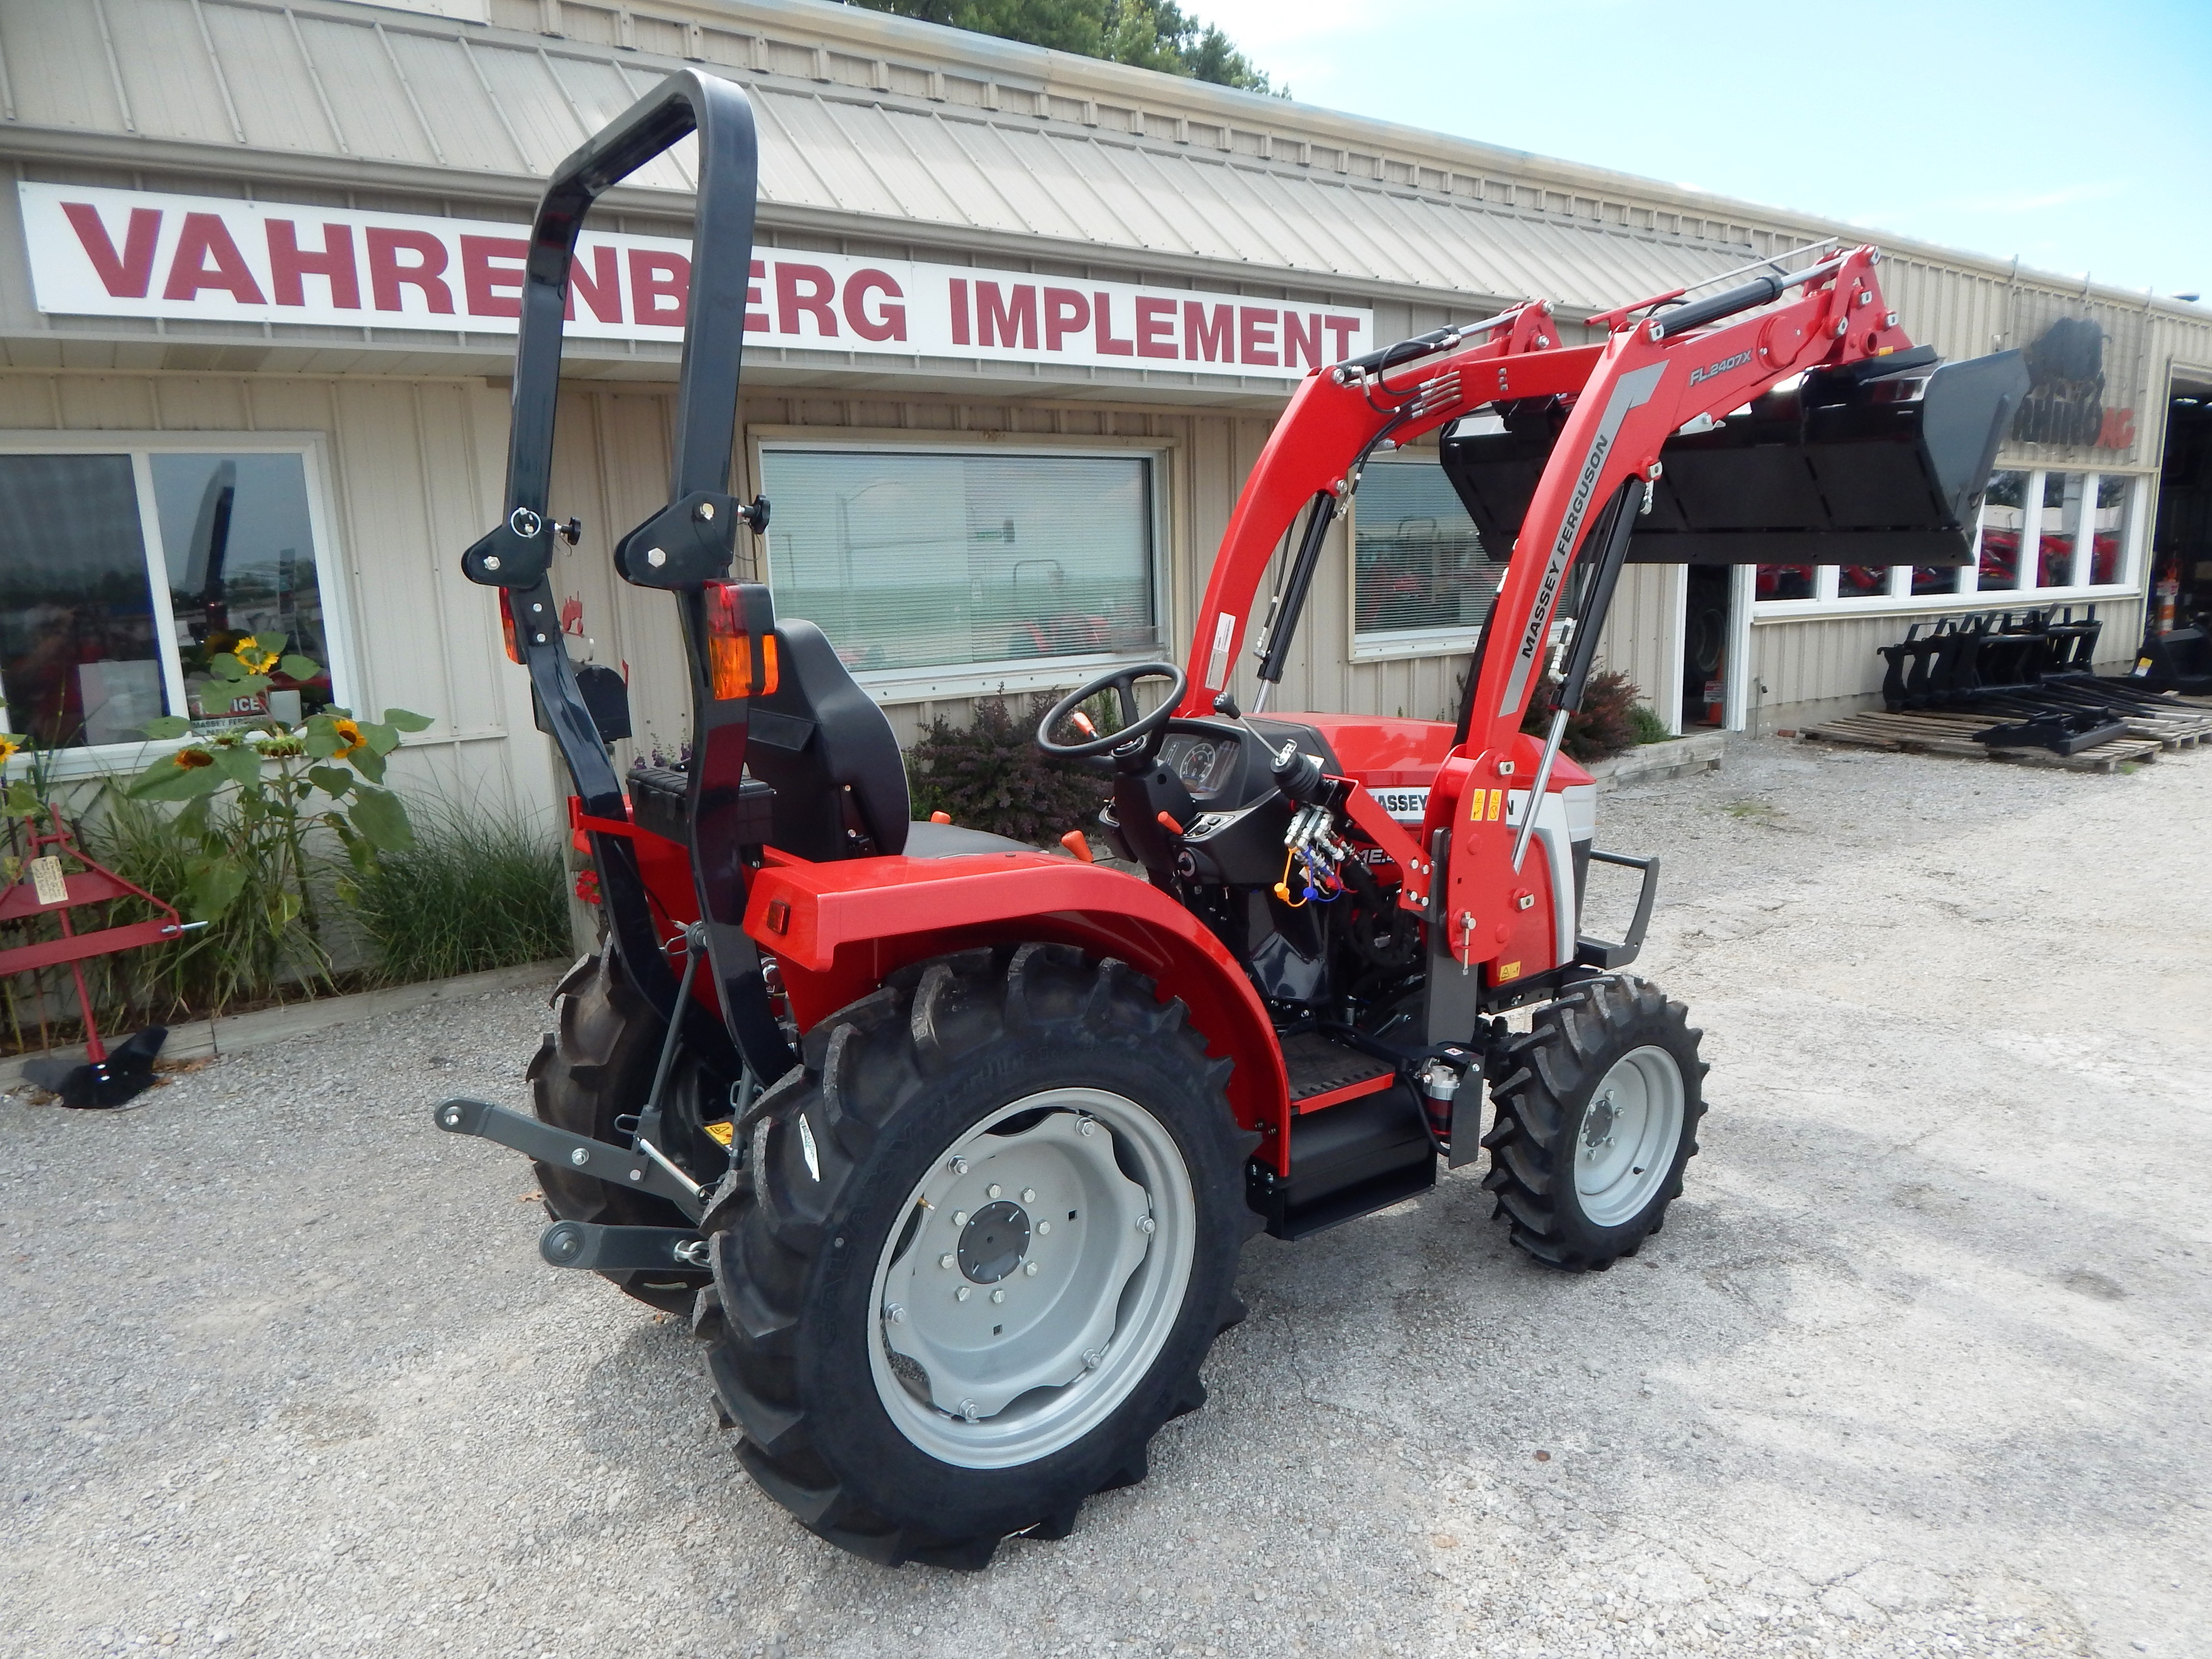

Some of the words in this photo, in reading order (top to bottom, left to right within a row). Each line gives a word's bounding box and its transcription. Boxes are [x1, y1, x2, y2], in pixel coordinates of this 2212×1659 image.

[949, 277, 1360, 369] IMPLEMENT
[1689, 348, 1753, 387] FL.2407X
[1522, 560, 1559, 659] MASSEY
[1557, 433, 1608, 556] FERGUSON
[199, 697, 260, 715] ICE
[1372, 794, 1428, 812] ASSEY
